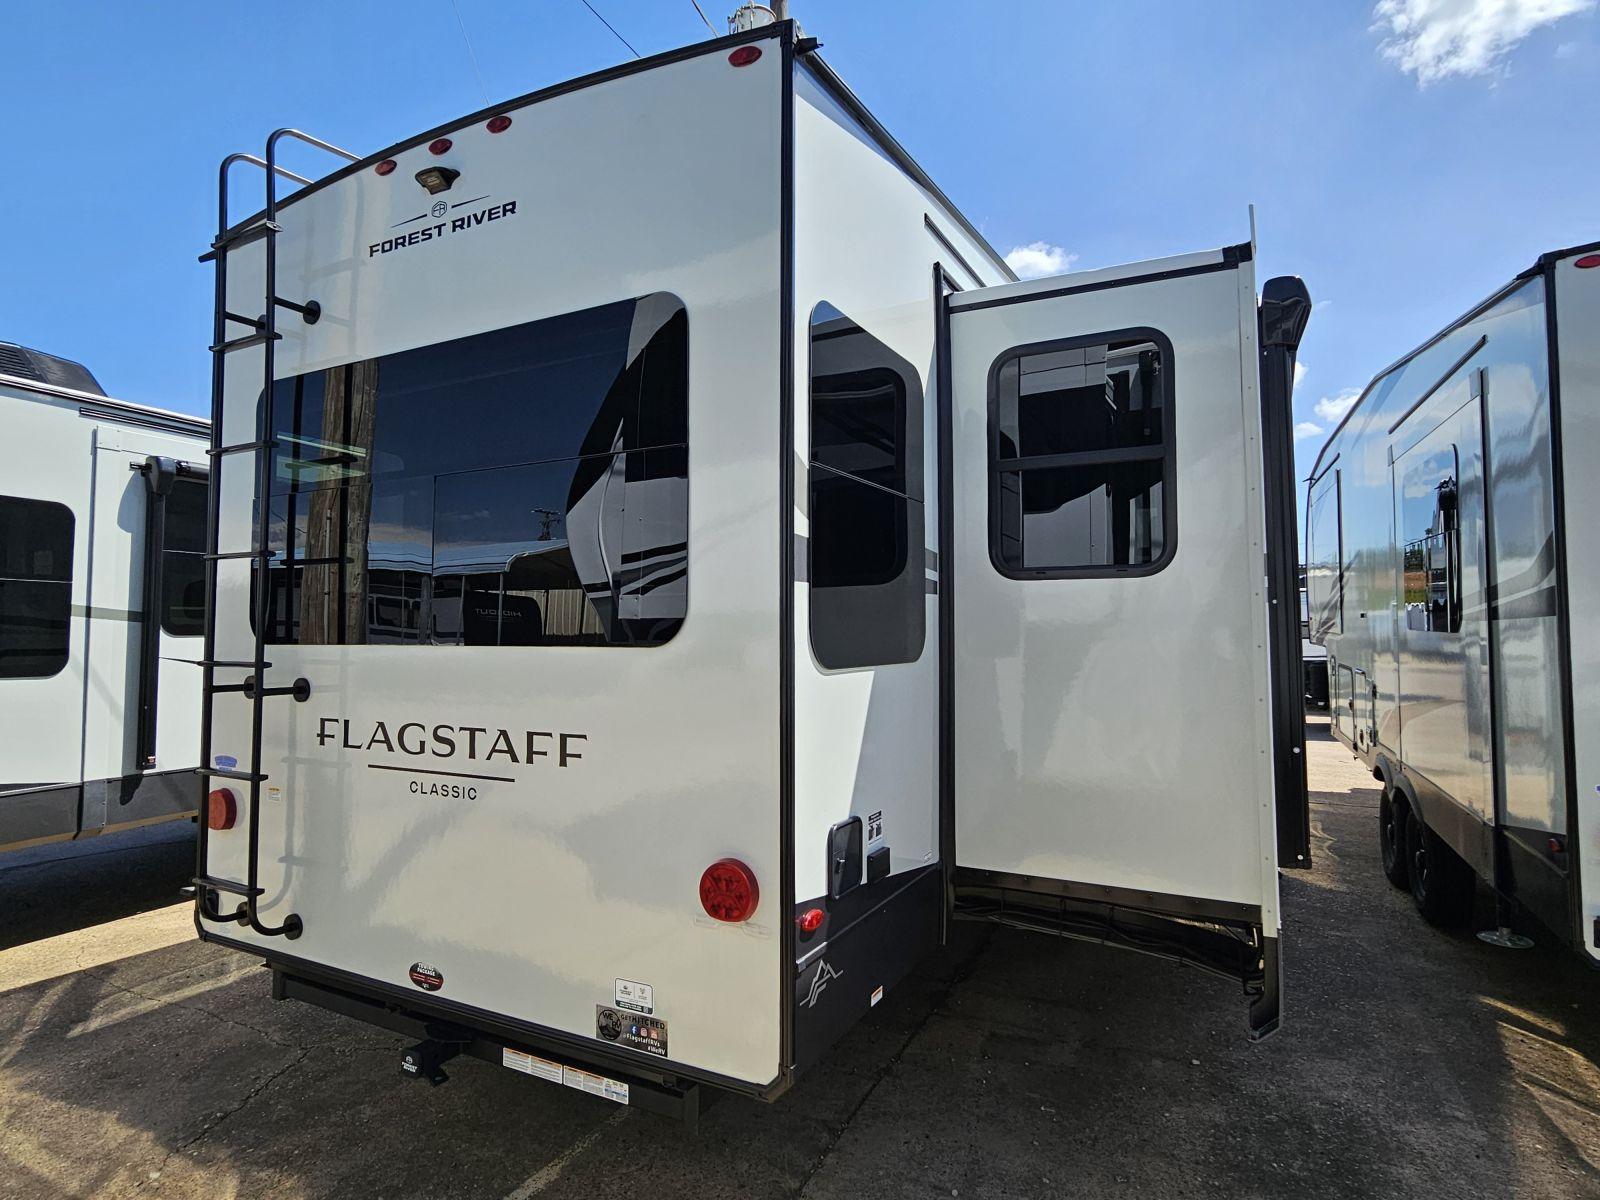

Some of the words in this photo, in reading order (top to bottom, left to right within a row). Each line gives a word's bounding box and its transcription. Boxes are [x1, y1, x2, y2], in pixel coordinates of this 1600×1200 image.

[368, 222, 447, 258] FOREST
[451, 200, 517, 233] RIVER
[316, 717, 588, 768] FLAGSTAFF
[409, 780, 477, 800] CLASSIC
